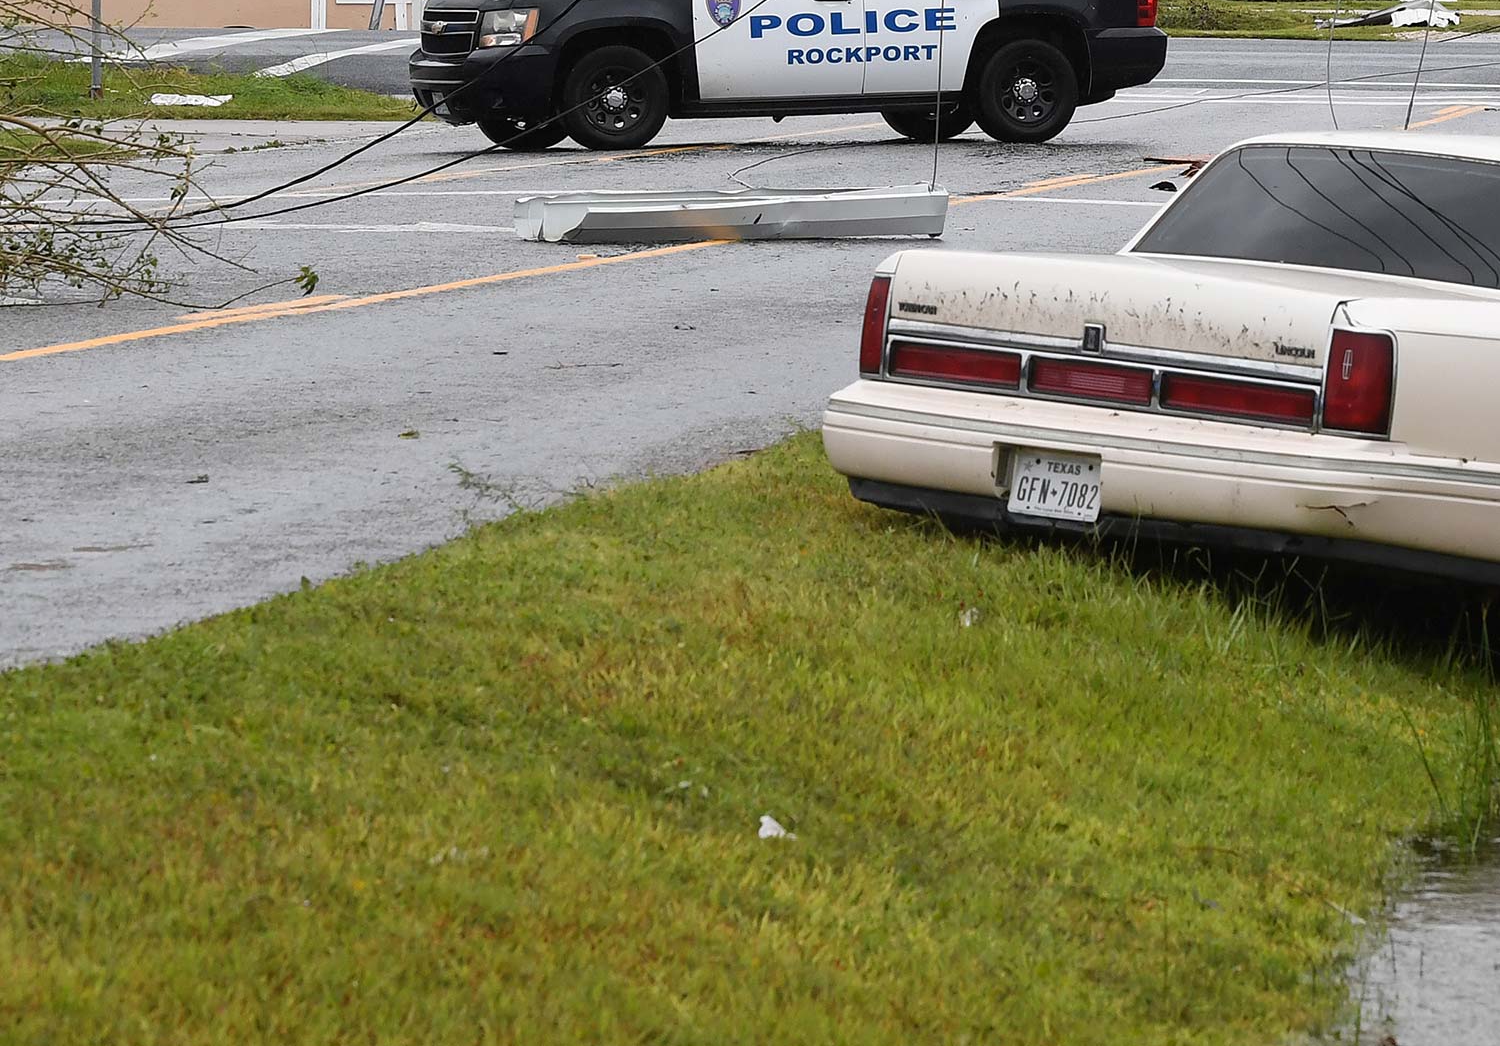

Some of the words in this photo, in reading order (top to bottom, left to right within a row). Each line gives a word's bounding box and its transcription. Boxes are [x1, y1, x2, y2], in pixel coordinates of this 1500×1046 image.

[750, 7, 957, 39] POLICE
[787, 44, 938, 65] ROCKPORT
[1047, 461, 1082, 476] TEXAS
